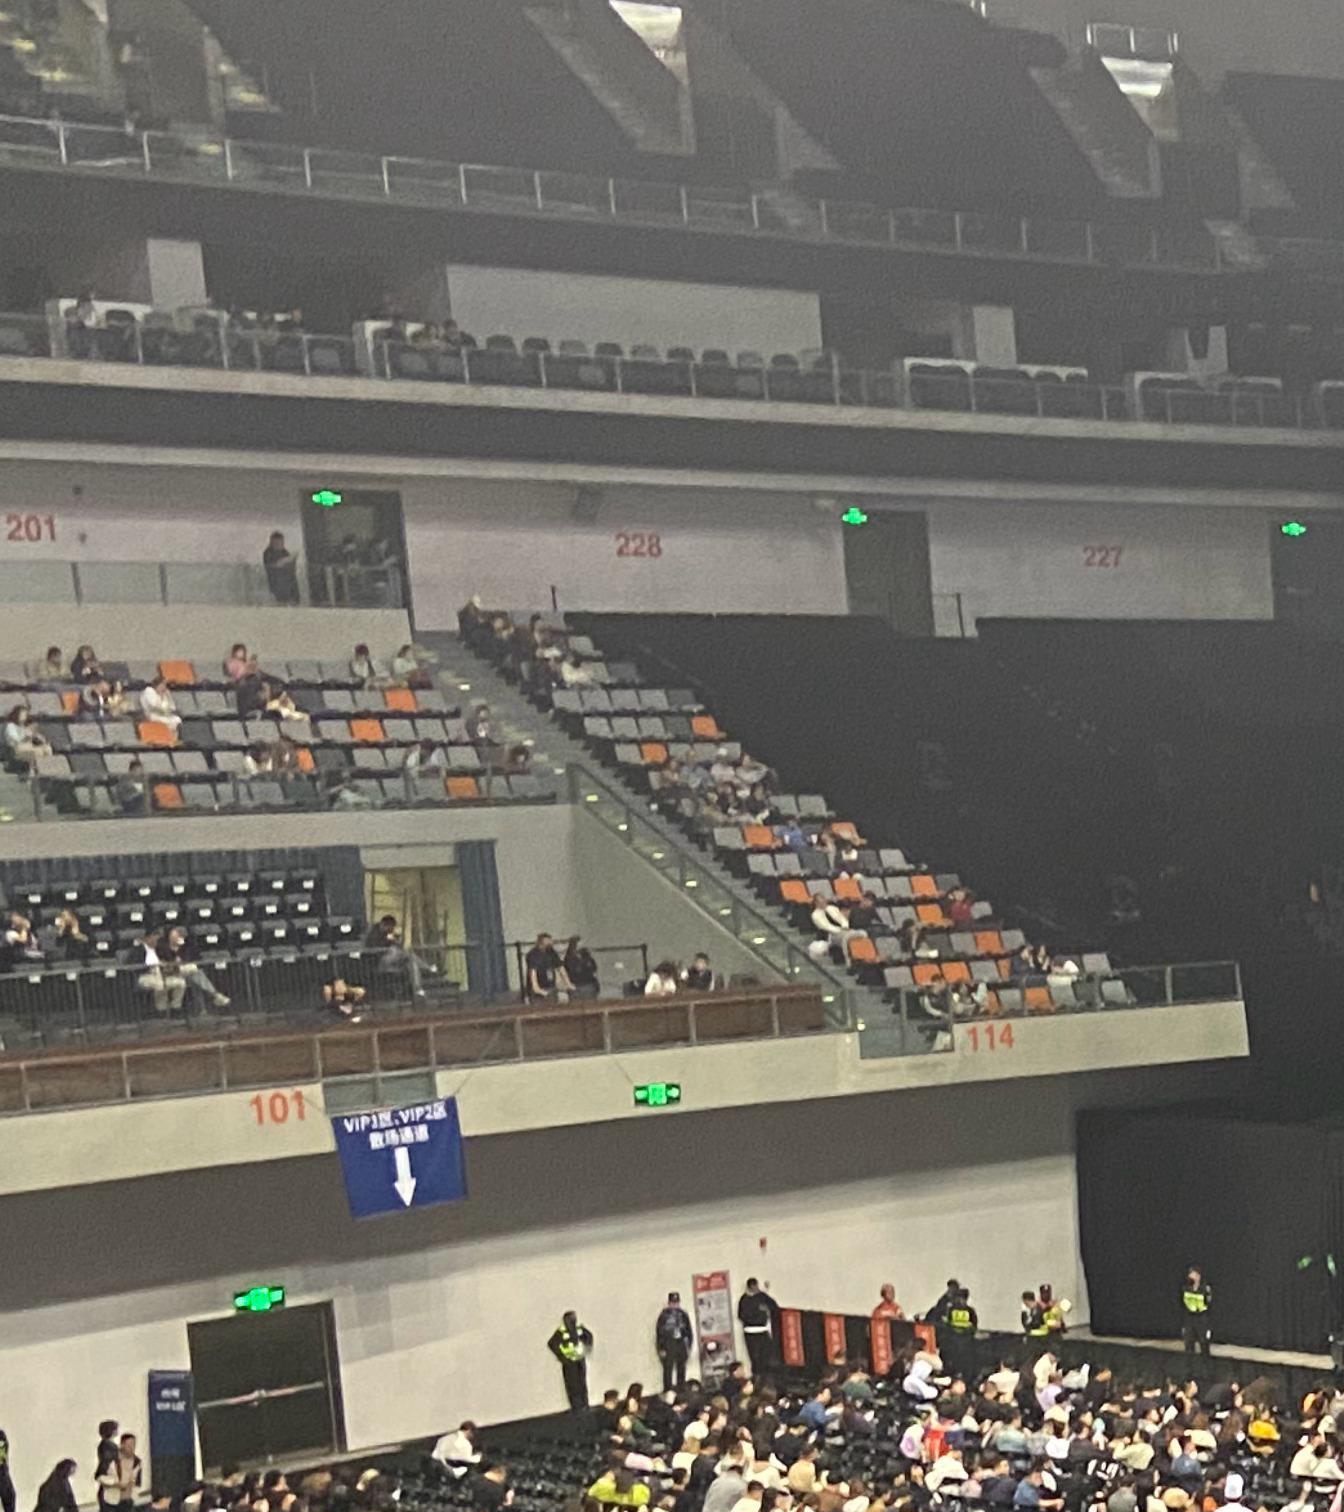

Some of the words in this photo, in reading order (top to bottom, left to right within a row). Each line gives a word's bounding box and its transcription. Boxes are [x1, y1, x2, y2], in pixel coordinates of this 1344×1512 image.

[4, 515, 57, 543] 201
[615, 532, 663, 558] 228
[1082, 544, 1123, 568] 227
[965, 1022, 1016, 1052] 114
[249, 1090, 308, 1127] 101
